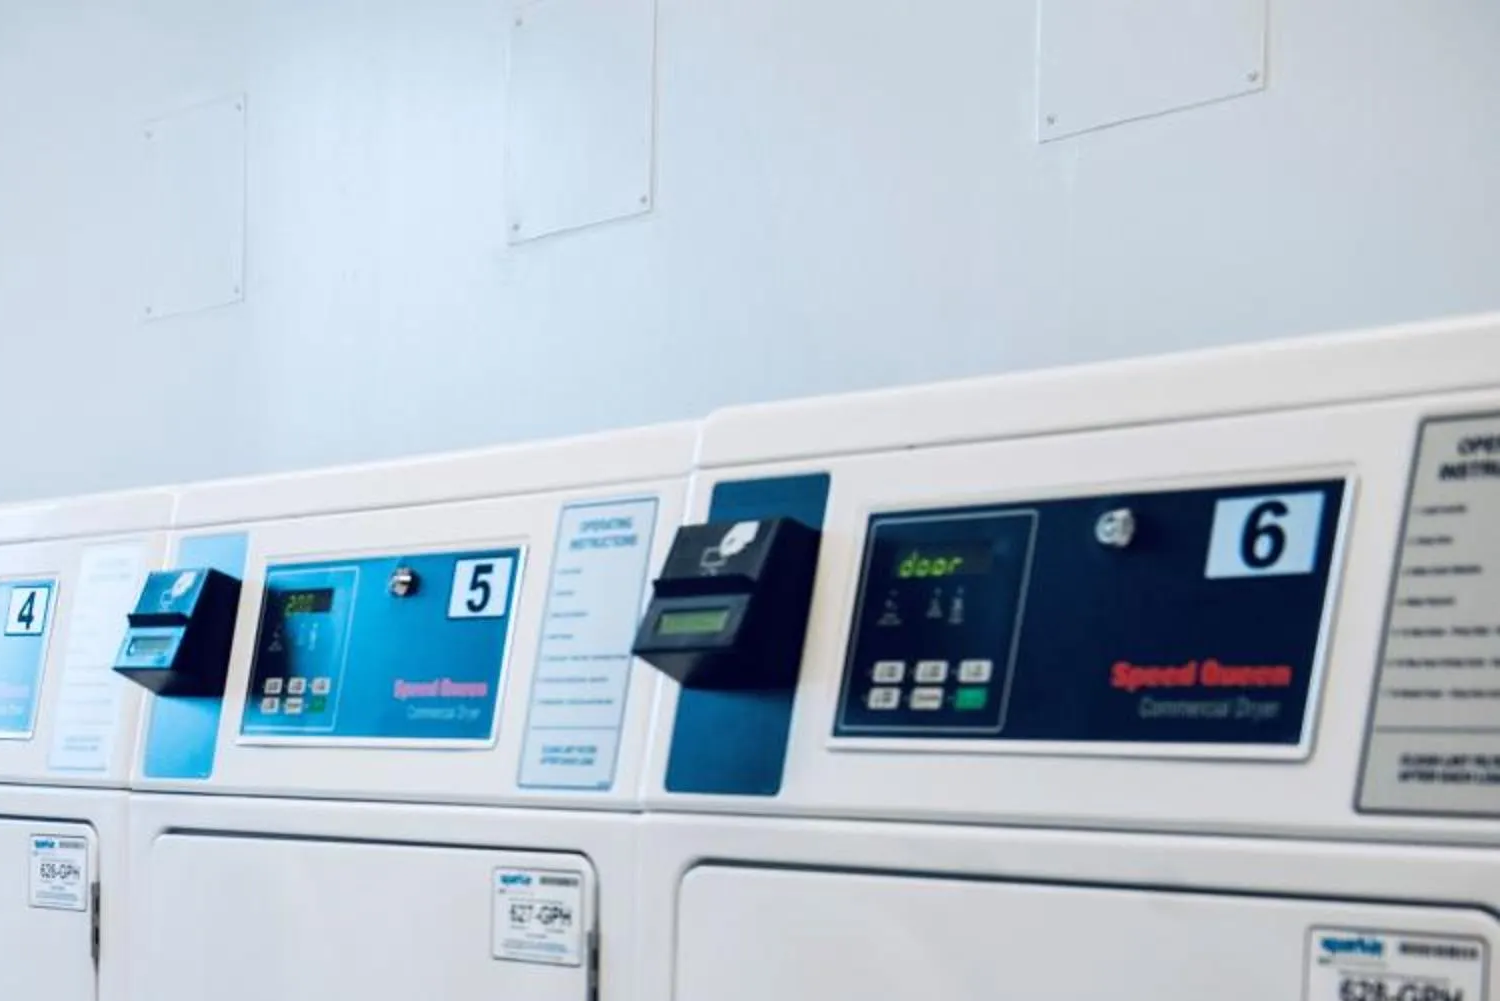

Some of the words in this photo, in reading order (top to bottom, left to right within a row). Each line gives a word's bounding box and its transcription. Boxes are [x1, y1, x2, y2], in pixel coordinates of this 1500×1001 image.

[1240, 500, 1289, 569] 6
[898, 551, 964, 578] door
[467, 563, 493, 613] 5
[17, 591, 36, 630] 4
[1112, 661, 1196, 693] Speed
[1202, 658, 1292, 687] Queen
